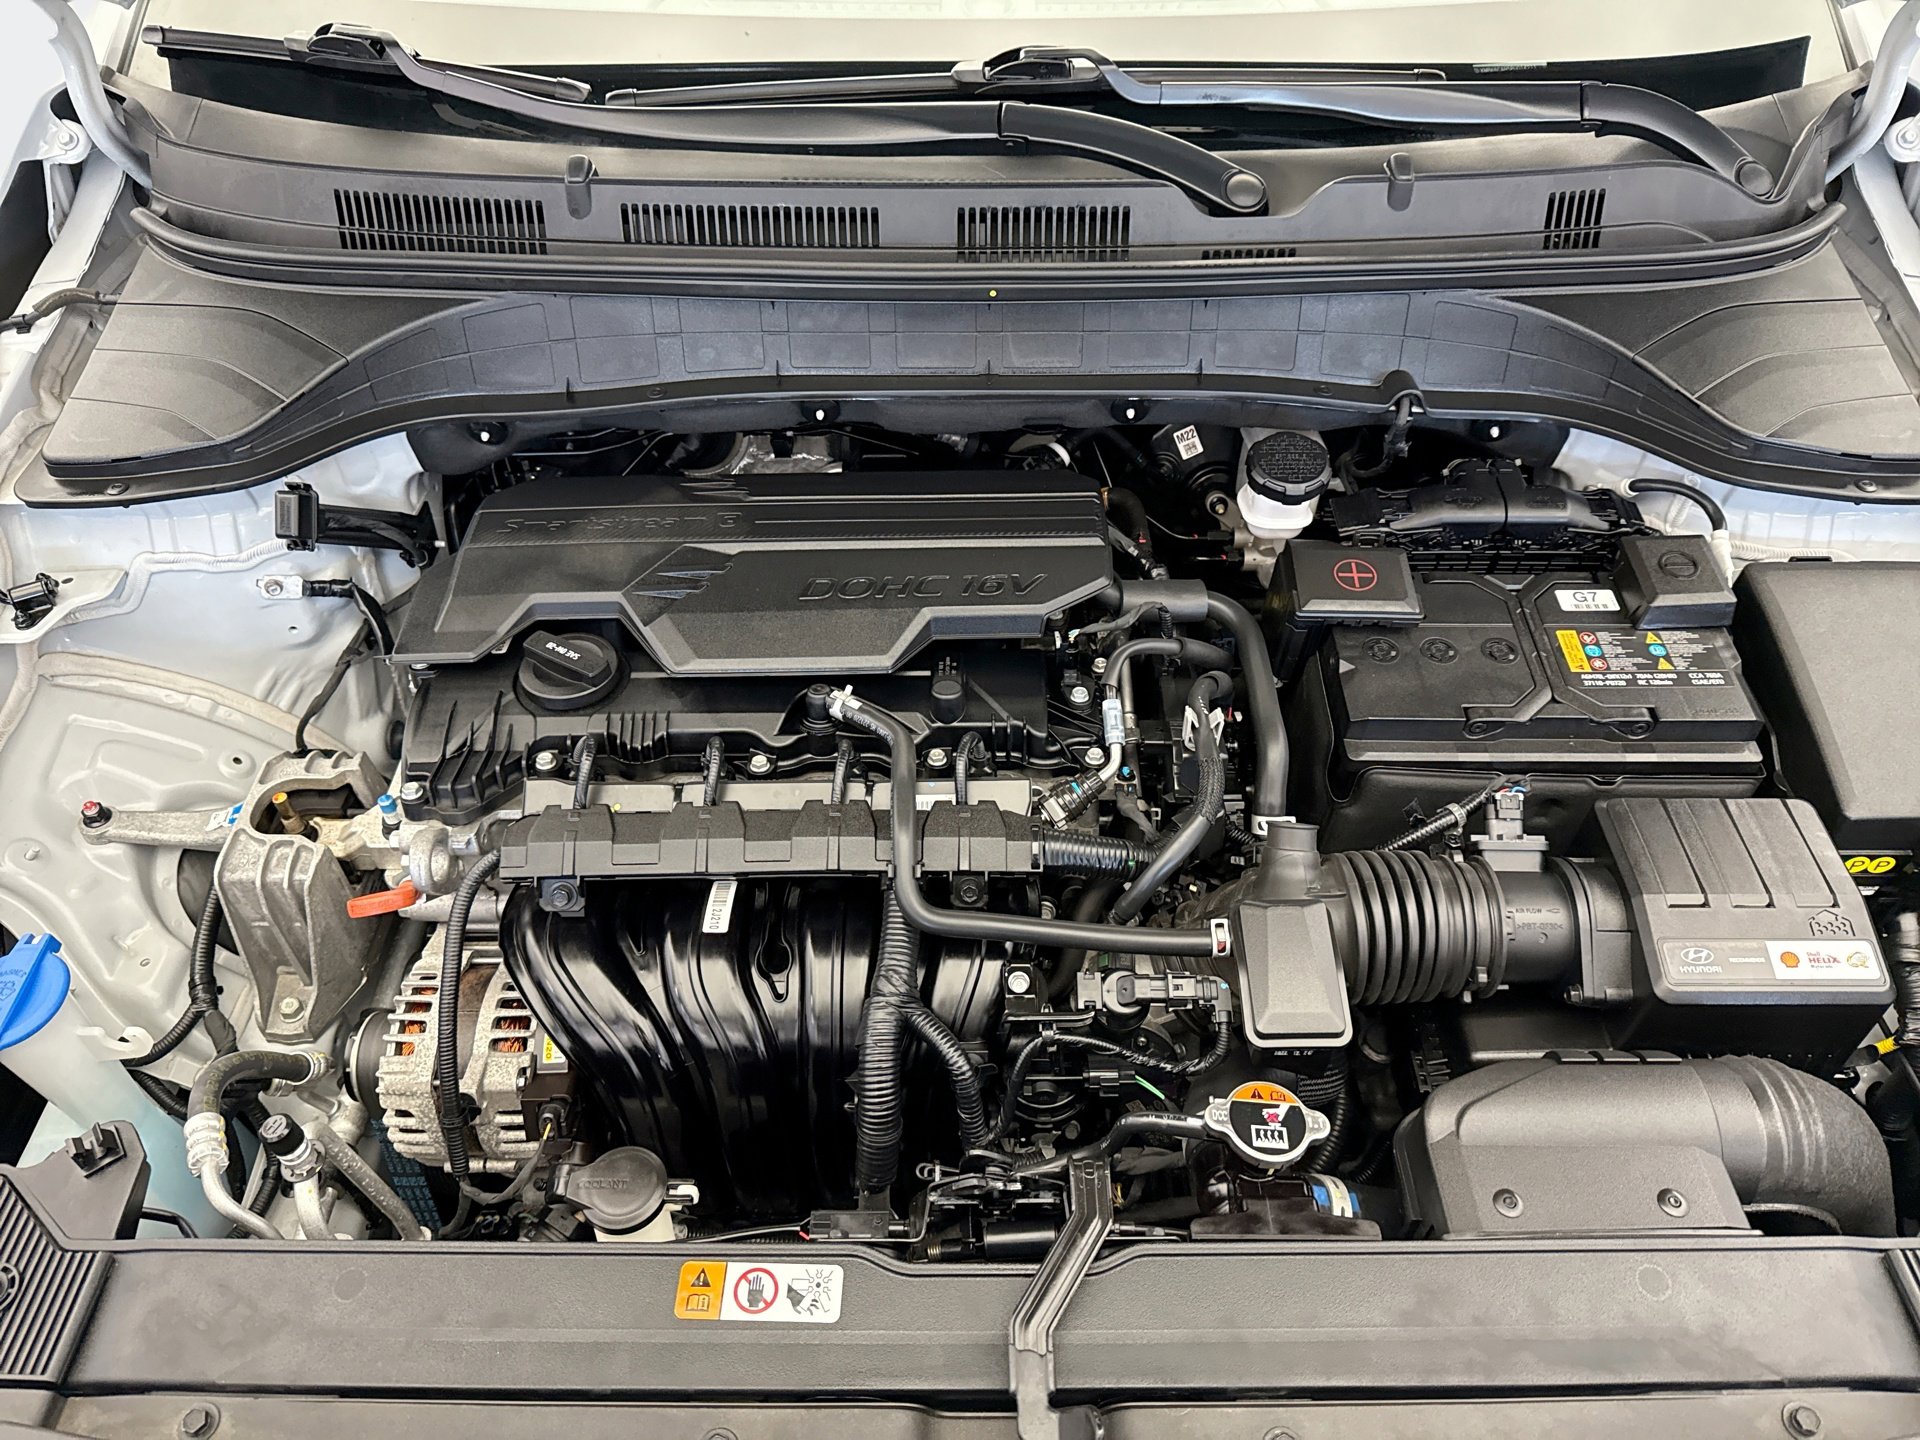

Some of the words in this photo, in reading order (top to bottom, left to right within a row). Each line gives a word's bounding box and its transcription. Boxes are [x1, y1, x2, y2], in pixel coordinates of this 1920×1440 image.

[1176, 428, 1197, 445] M22
[798, 575, 950, 601] DOHC
[961, 573, 1048, 597] 16V
[1572, 591, 1597, 603] G7
[564, 650, 581, 660] SAE
[1808, 955, 1841, 964] HELIX
[1680, 966, 1722, 974] HYUNDAI
[1212, 1109, 1228, 1121] DCC
[1307, 1116, 1324, 1129] 1.1
